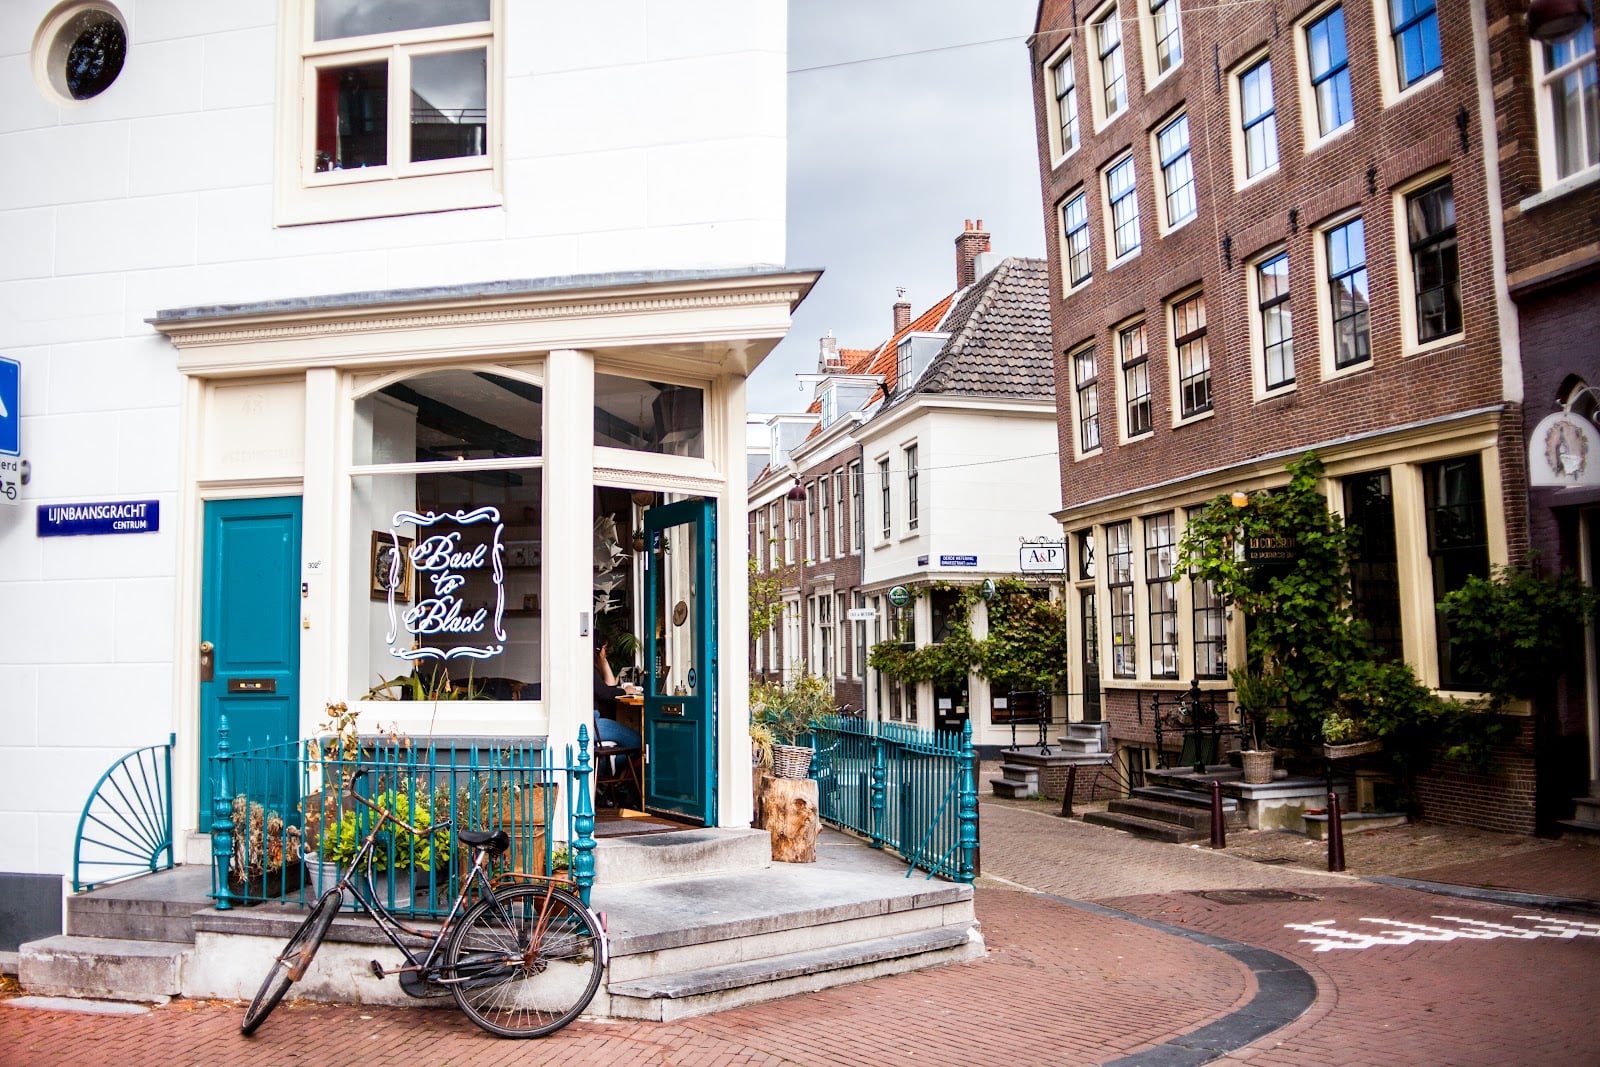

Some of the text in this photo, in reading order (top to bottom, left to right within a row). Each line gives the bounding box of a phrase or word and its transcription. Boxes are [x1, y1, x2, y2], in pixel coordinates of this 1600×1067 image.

[48, 504, 146, 524] LIJNBAANSGRACHT
[113, 519, 147, 530] CENTRUM
[409, 532, 488, 570] Back
[1029, 549, 1057, 563] A&P
[430, 570, 465, 596] to
[402, 596, 488, 634] Black
